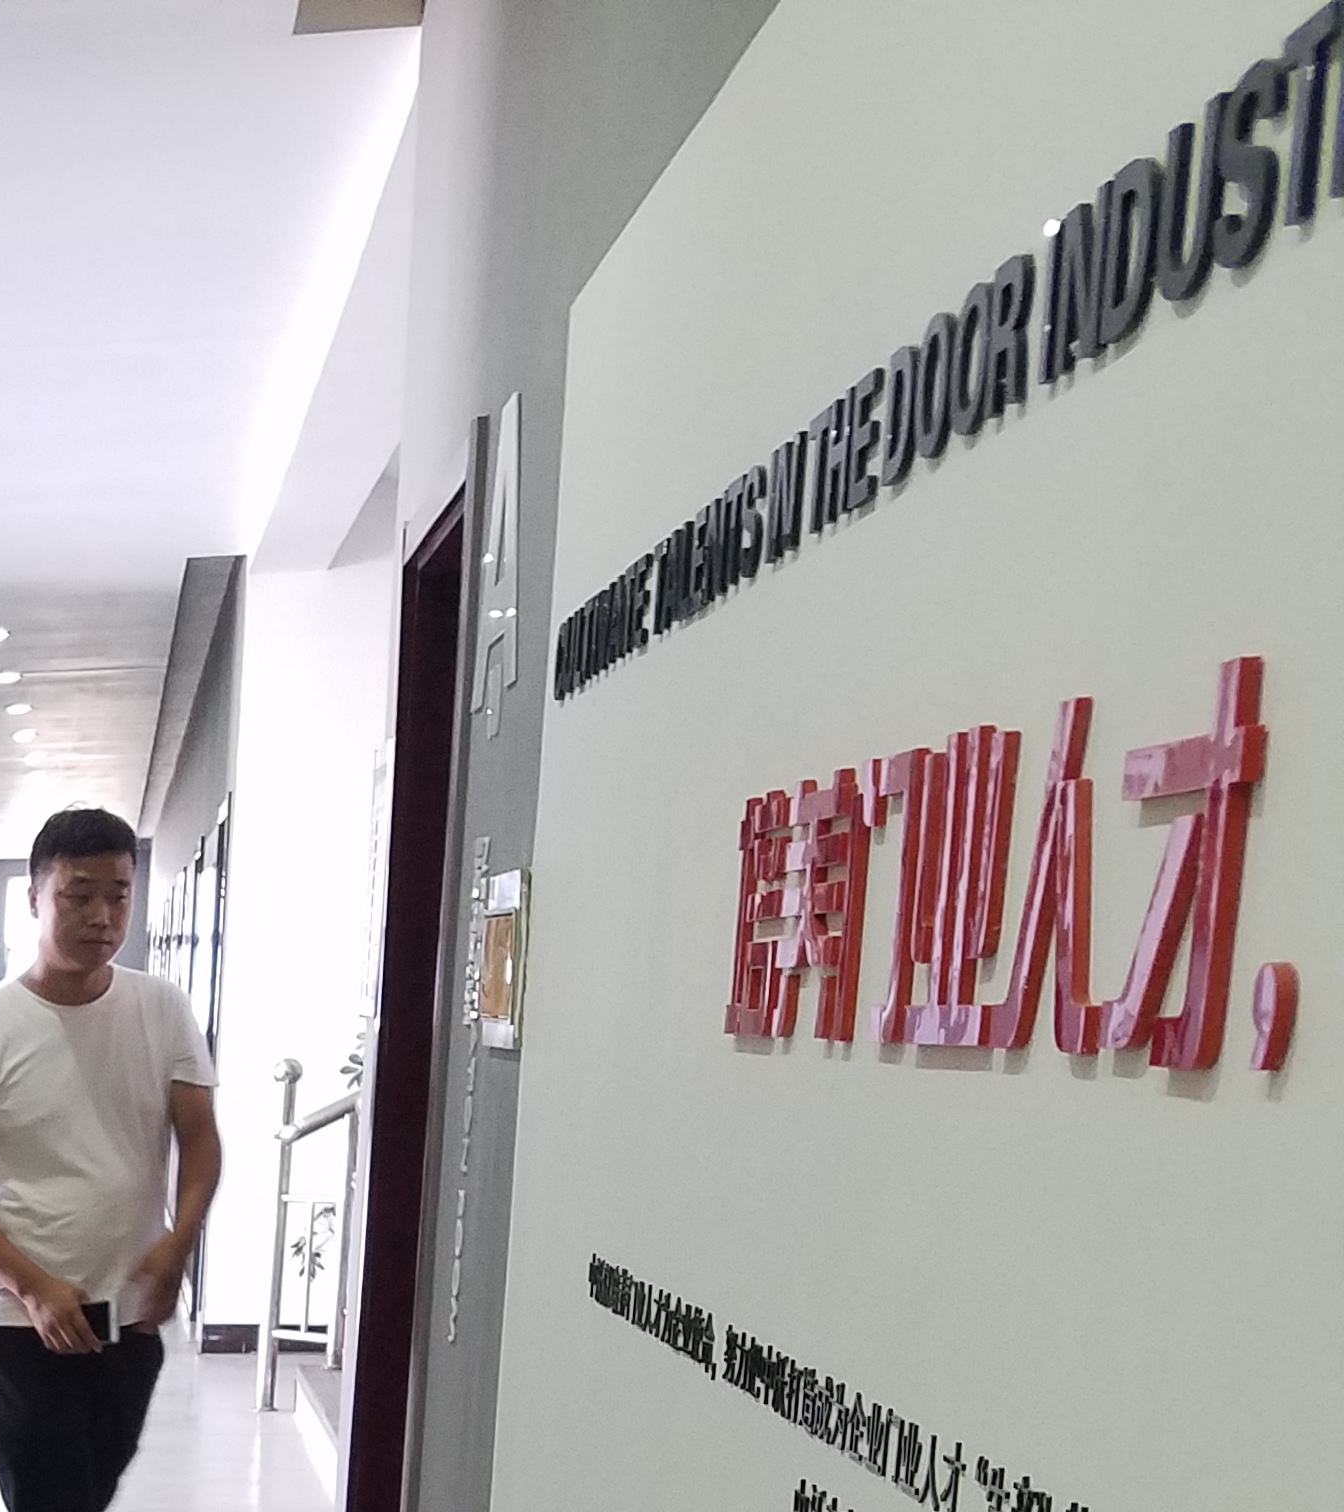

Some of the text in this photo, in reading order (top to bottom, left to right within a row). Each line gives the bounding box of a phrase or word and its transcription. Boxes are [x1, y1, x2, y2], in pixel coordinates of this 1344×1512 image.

[765, 431, 809, 563] IN
[809, 367, 885, 534] THE
[881, 253, 1035, 486] DOOR
[1038, 0, 1344, 386] INDUST
